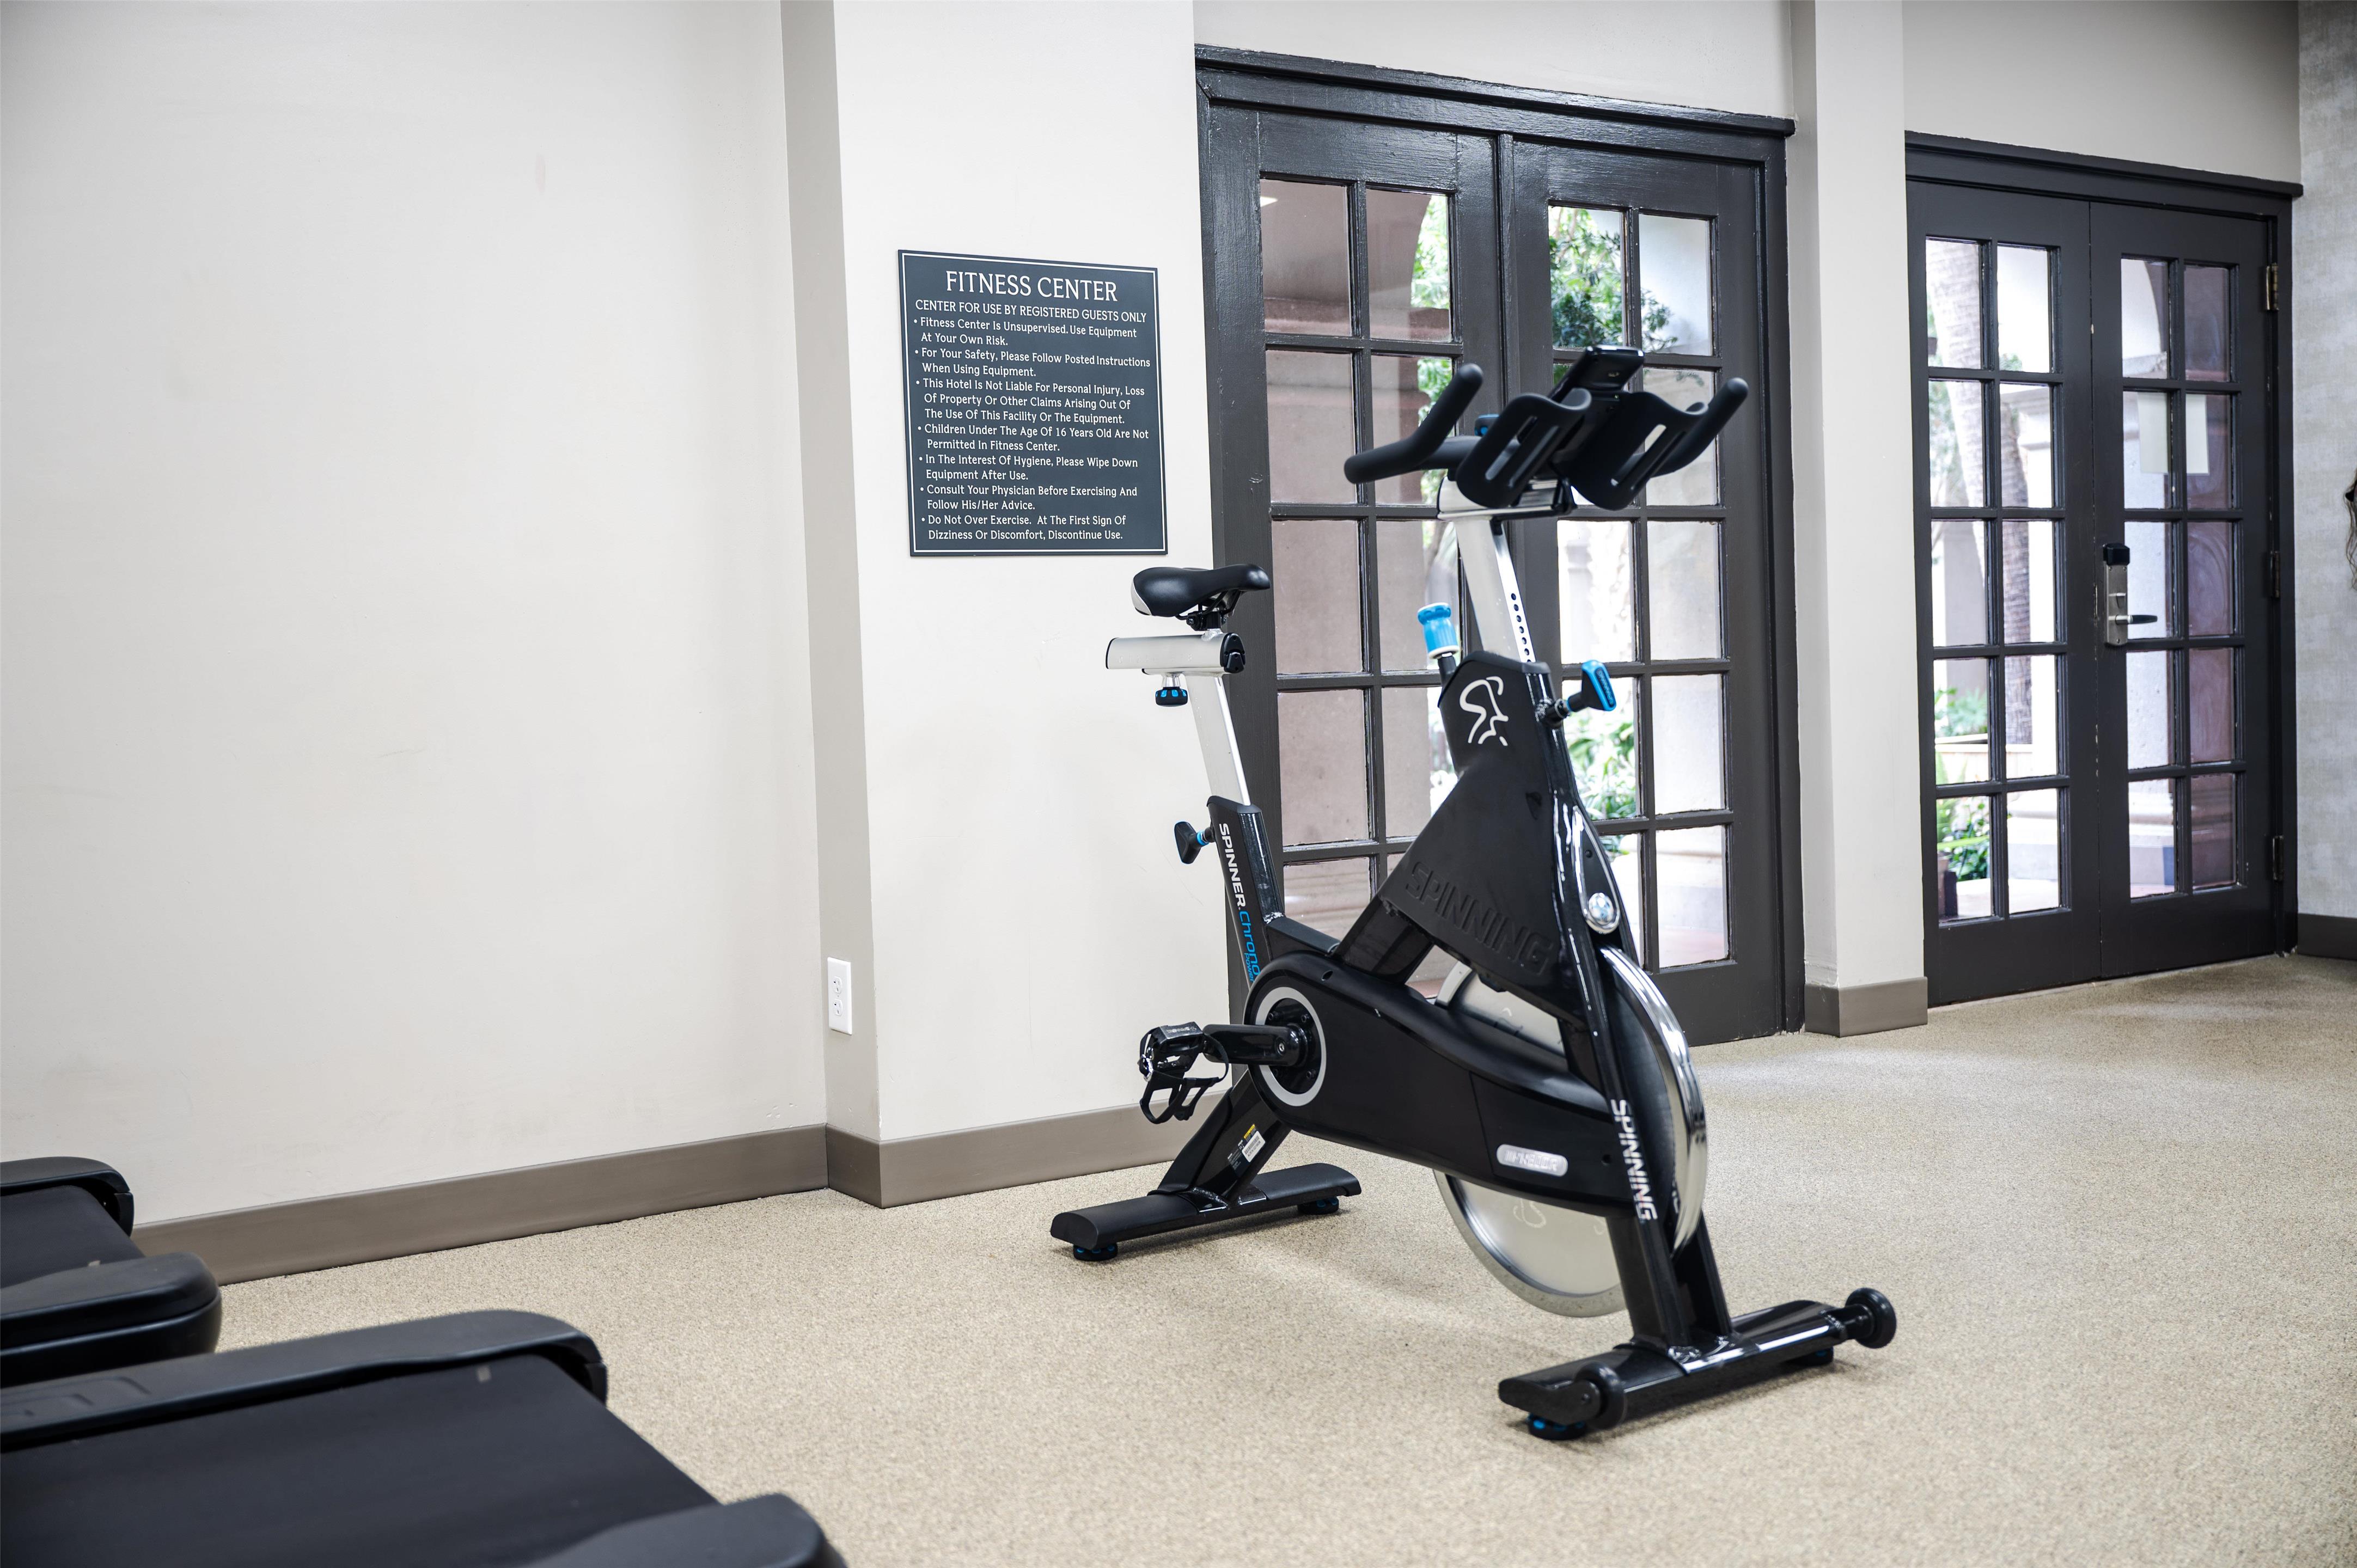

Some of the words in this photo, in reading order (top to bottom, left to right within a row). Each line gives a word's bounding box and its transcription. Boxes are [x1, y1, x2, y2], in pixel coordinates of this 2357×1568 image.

[946, 270, 1031, 296] FITNESS
[1037, 277, 1118, 302] CENTER
[915, 299, 956, 312] CENTER
[958, 302, 980, 314] FOR
[982, 303, 1002, 315] USE
[1004, 304, 1017, 315] BY
[1019, 305, 1079, 319] REGISTERED
[1082, 309, 1119, 321] GUESTS
[1121, 311, 1147, 323] ONLY
[920, 316, 955, 328] Fitness
[957, 318, 990, 330] Center
[993, 321, 1001, 330] Is
[1003, 321, 1068, 334] Unsupervised.
[1070, 324, 1086, 335] Use
[1088, 326, 1137, 339] Equipment
[920, 332, 932, 342] At
[935, 333, 957, 343] Your
[960, 334, 984, 345] Own
[986, 335, 1008, 346] Risk.
[921, 347, 937, 358] For
[939, 348, 962, 359] Your
[964, 348, 998, 362] Safety,
[1000, 351, 1030, 362] Please
[1032, 352, 1062, 363] Follow
[1065, 354, 1095, 365] Posted
[1096, 356, 1151, 367] Instructions
[921, 362, 950, 373] When
[953, 364, 980, 377] Using
[982, 365, 1036, 378] Equipment.
[923, 377, 943, 388] This
[946, 378, 972, 389] Hotel
[974, 379, 983, 390] Is
[985, 380, 1003, 390] Not
[1005, 381, 1033, 391] Liable
[1035, 382, 1051, 392] For
[1053, 383, 1091, 394] Personal
[1094, 384, 1123, 397] Injury,
[1125, 385, 1145, 396] Loss
[924, 393, 937, 403] Of
[939, 394, 982, 407] Property
[985, 395, 997, 405] Or
[999, 396, 1028, 406] Other
[1030, 396, 1062, 407] Claims
[1064, 398, 1097, 411] Arising
[1099, 399, 1117, 409] Out
[1119, 399, 1131, 410] Of
[924, 408, 943, 419] The
[945, 409, 963, 419] Use
[965, 409, 978, 419] Of
[980, 410, 1000, 420] This
[1003, 411, 1037, 424] Facility
[1039, 412, 1052, 422] Or
[1054, 412, 1071, 422] The
[1073, 413, 1125, 425] Equipment.
[924, 423, 966, 434] Children
[968, 425, 997, 435] Under
[999, 425, 1017, 436] The
[1019, 426, 1038, 438] Age
[1040, 426, 1053, 437] Of
[1055, 427, 1067, 437] 16
[1069, 427, 1094, 438] Years
[1096, 428, 1112, 438] Old
[1114, 428, 1130, 438] Are
[1133, 429, 1149, 439] Not
[927, 439, 975, 450] Permitted
[978, 440, 988, 450] In
[990, 440, 1024, 451] Fitness
[1026, 441, 1060, 451] Center.
[925, 454, 935, 464] In
[937, 454, 956, 464] The
[958, 455, 997, 465] Interest
[998, 455, 1011, 465] Of
[1013, 456, 1054, 468] Hygiene,
[1056, 456, 1084, 467] Please
[1086, 457, 1109, 469] Wipe
[1112, 457, 1138, 468] Down
[926, 469, 979, 481] Equipment
[981, 469, 1007, 480] After
[1009, 470, 1029, 480] Use.
[926, 484, 965, 494] Consult
[967, 485, 990, 495] Your
[992, 485, 1035, 497] Physician
[1038, 485, 1068, 495] Before
[1070, 486, 1117, 498] Exercising
[1119, 486, 1138, 496] And
[927, 499, 959, 510] Follow
[961, 500, 999, 510] His/Her
[1001, 500, 1035, 510] Advice.
[928, 514, 942, 524] Do
[944, 514, 962, 524] Not
[964, 514, 988, 525] Over
[990, 515, 1032, 525] Exercise.
[1037, 515, 1048, 525] At
[1049, 515, 1067, 525] The
[1069, 515, 1090, 525] First
[1092, 515, 1112, 527] Sign
[1114, 514, 1126, 525] Of
[928, 529, 973, 540] Dizziness
[975, 530, 988, 540] Or
[990, 529, 1046, 541] Discomfort,
[1048, 530, 1102, 540] Discontinue
[1104, 530, 1123, 540] Use.
[1219, 823, 1246, 912] SPINNER
[1406, 861, 1553, 976] SPINNING
[1610, 1099, 1658, 1221] SPINNING
